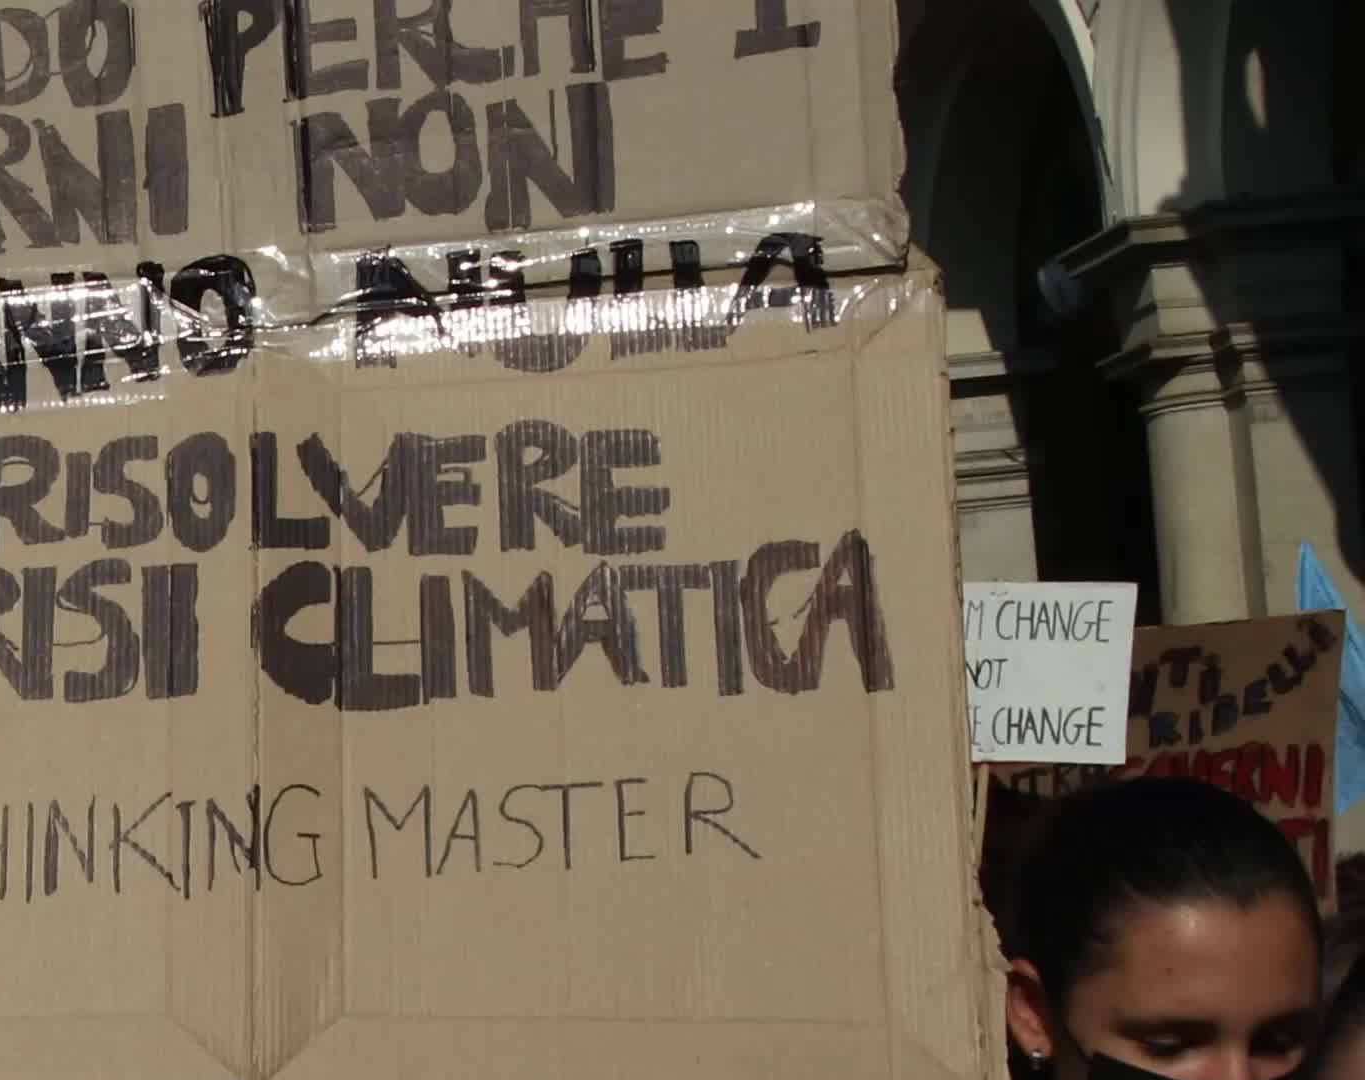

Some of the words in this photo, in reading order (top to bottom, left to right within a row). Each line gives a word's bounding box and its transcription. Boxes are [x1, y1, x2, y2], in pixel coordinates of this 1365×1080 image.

[292, 81, 616, 234] NON
[251, 527, 895, 713] CLIMATICA
[995, 600, 1114, 643] CHANGE
[992, 706, 1106, 747] CHANGE
[364, 771, 762, 879] MASTER
